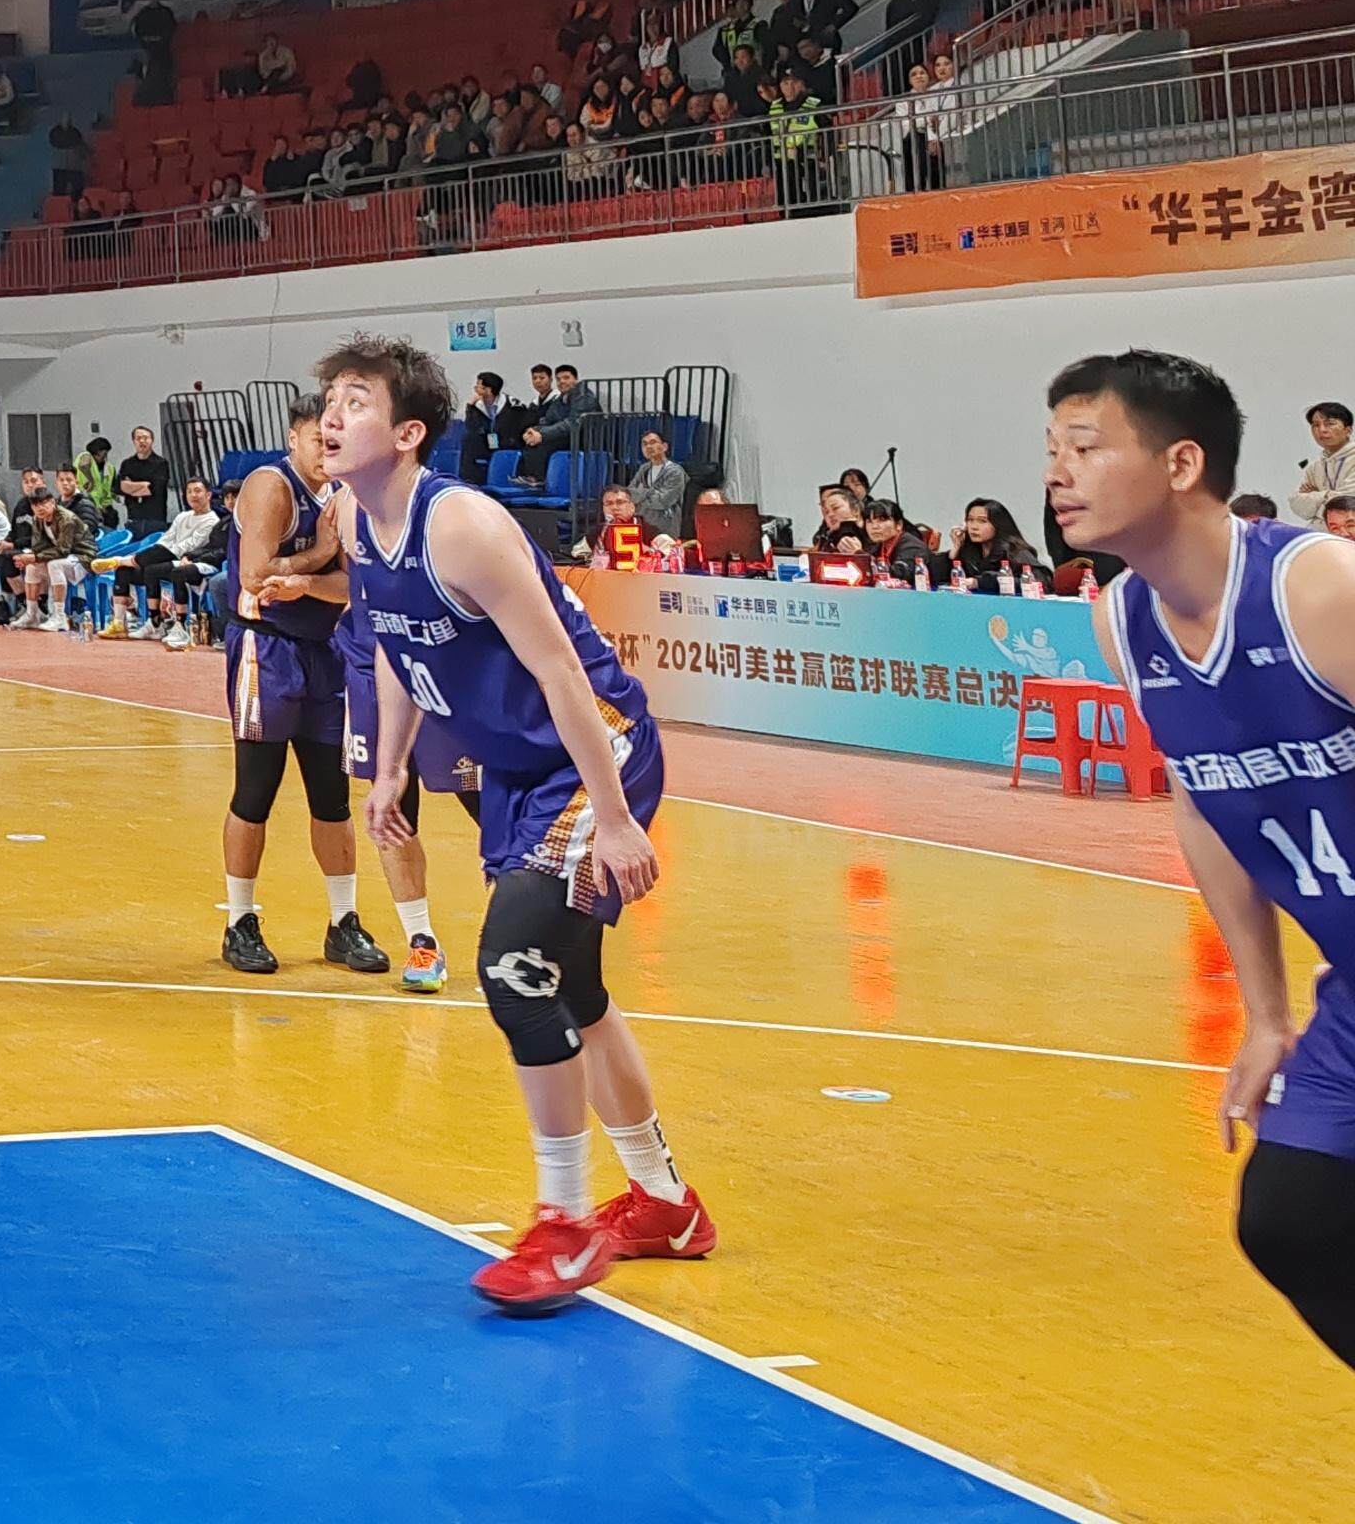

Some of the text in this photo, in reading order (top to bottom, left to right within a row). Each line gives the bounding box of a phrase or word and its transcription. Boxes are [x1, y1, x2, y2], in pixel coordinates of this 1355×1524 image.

[456, 321, 487, 338] 休息区
[613, 526, 641, 571] 5
[731, 596, 778, 615] 华丰国贸
[1259, 808, 1355, 897] 14
